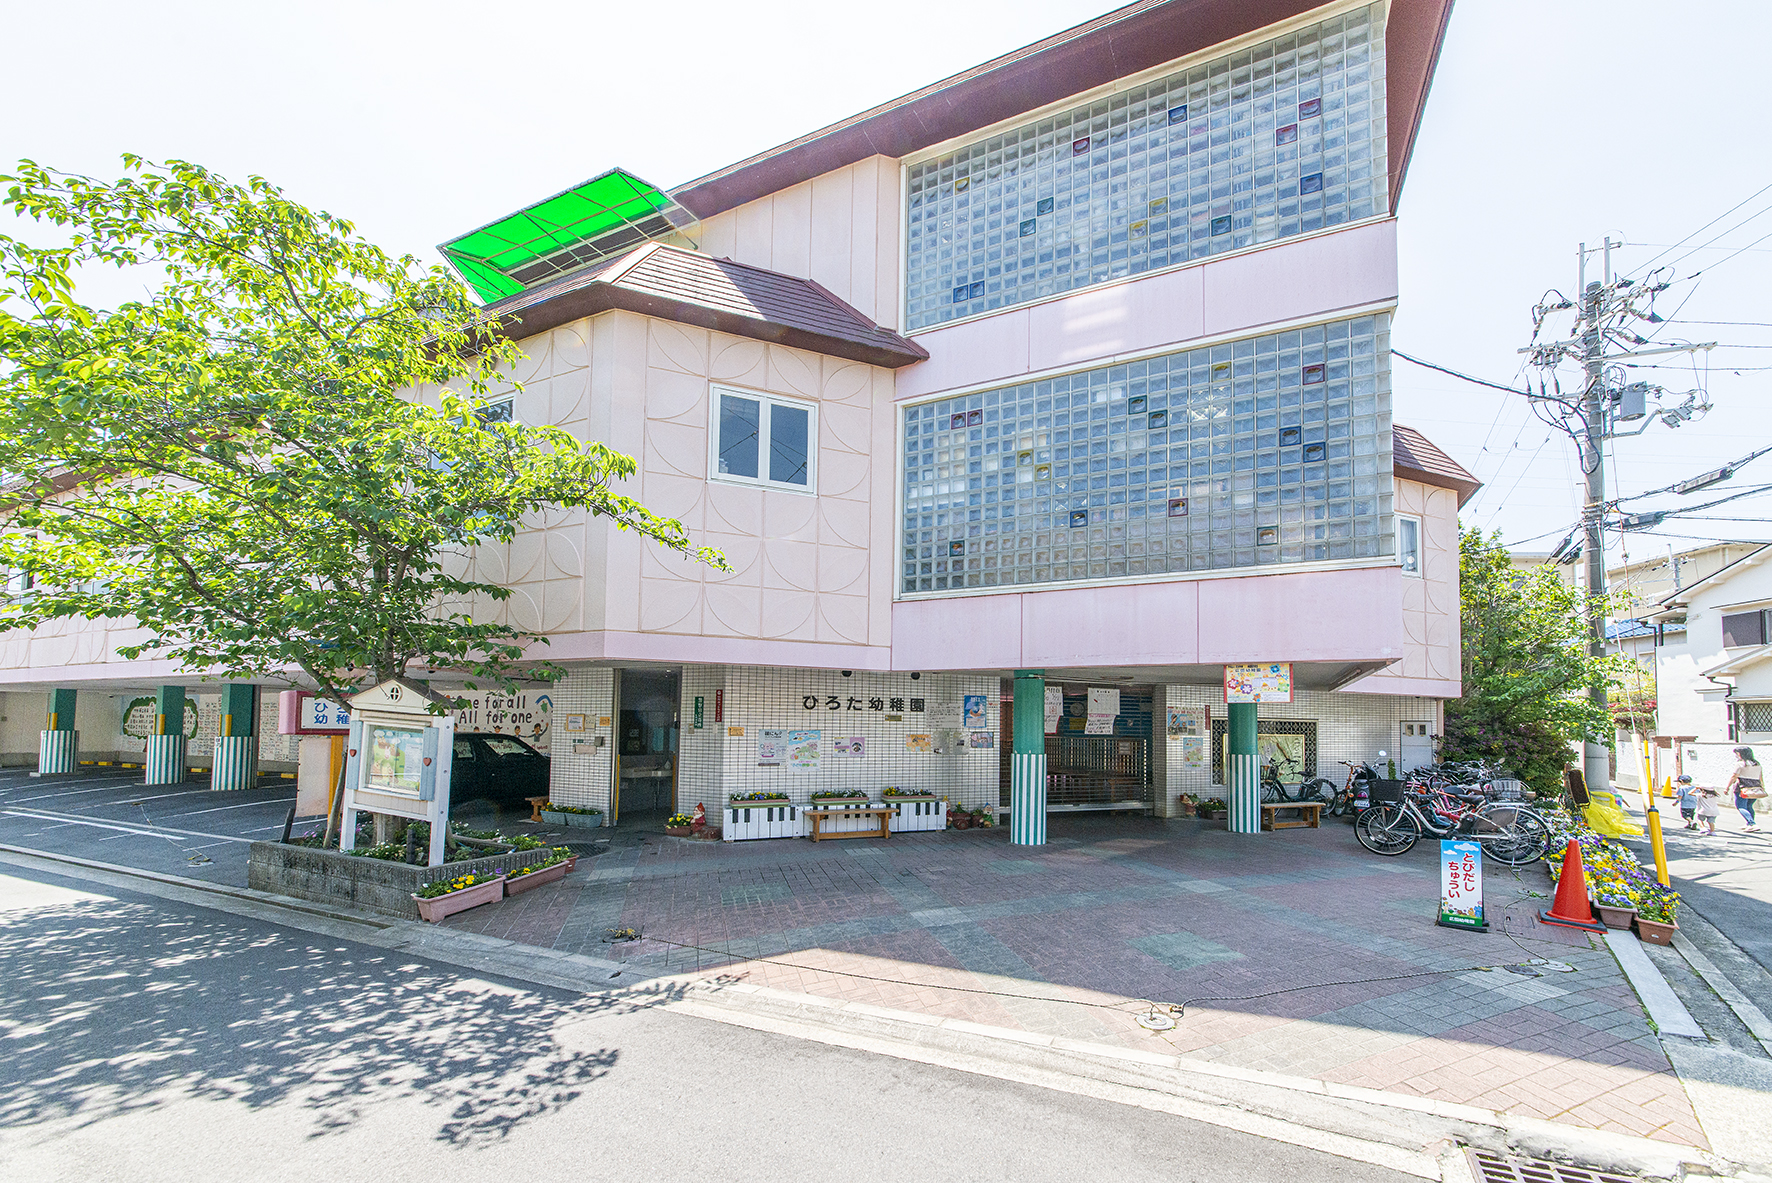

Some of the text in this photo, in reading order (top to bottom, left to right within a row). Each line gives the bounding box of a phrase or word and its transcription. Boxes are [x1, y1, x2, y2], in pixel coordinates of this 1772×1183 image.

[459, 710, 478, 724] All
[511, 712, 533, 724] one
[802, 695, 925, 712] ひろた幼稚園
[1447, 860, 1461, 899] ちゅうい
[1462, 852, 1476, 892] とびだし
